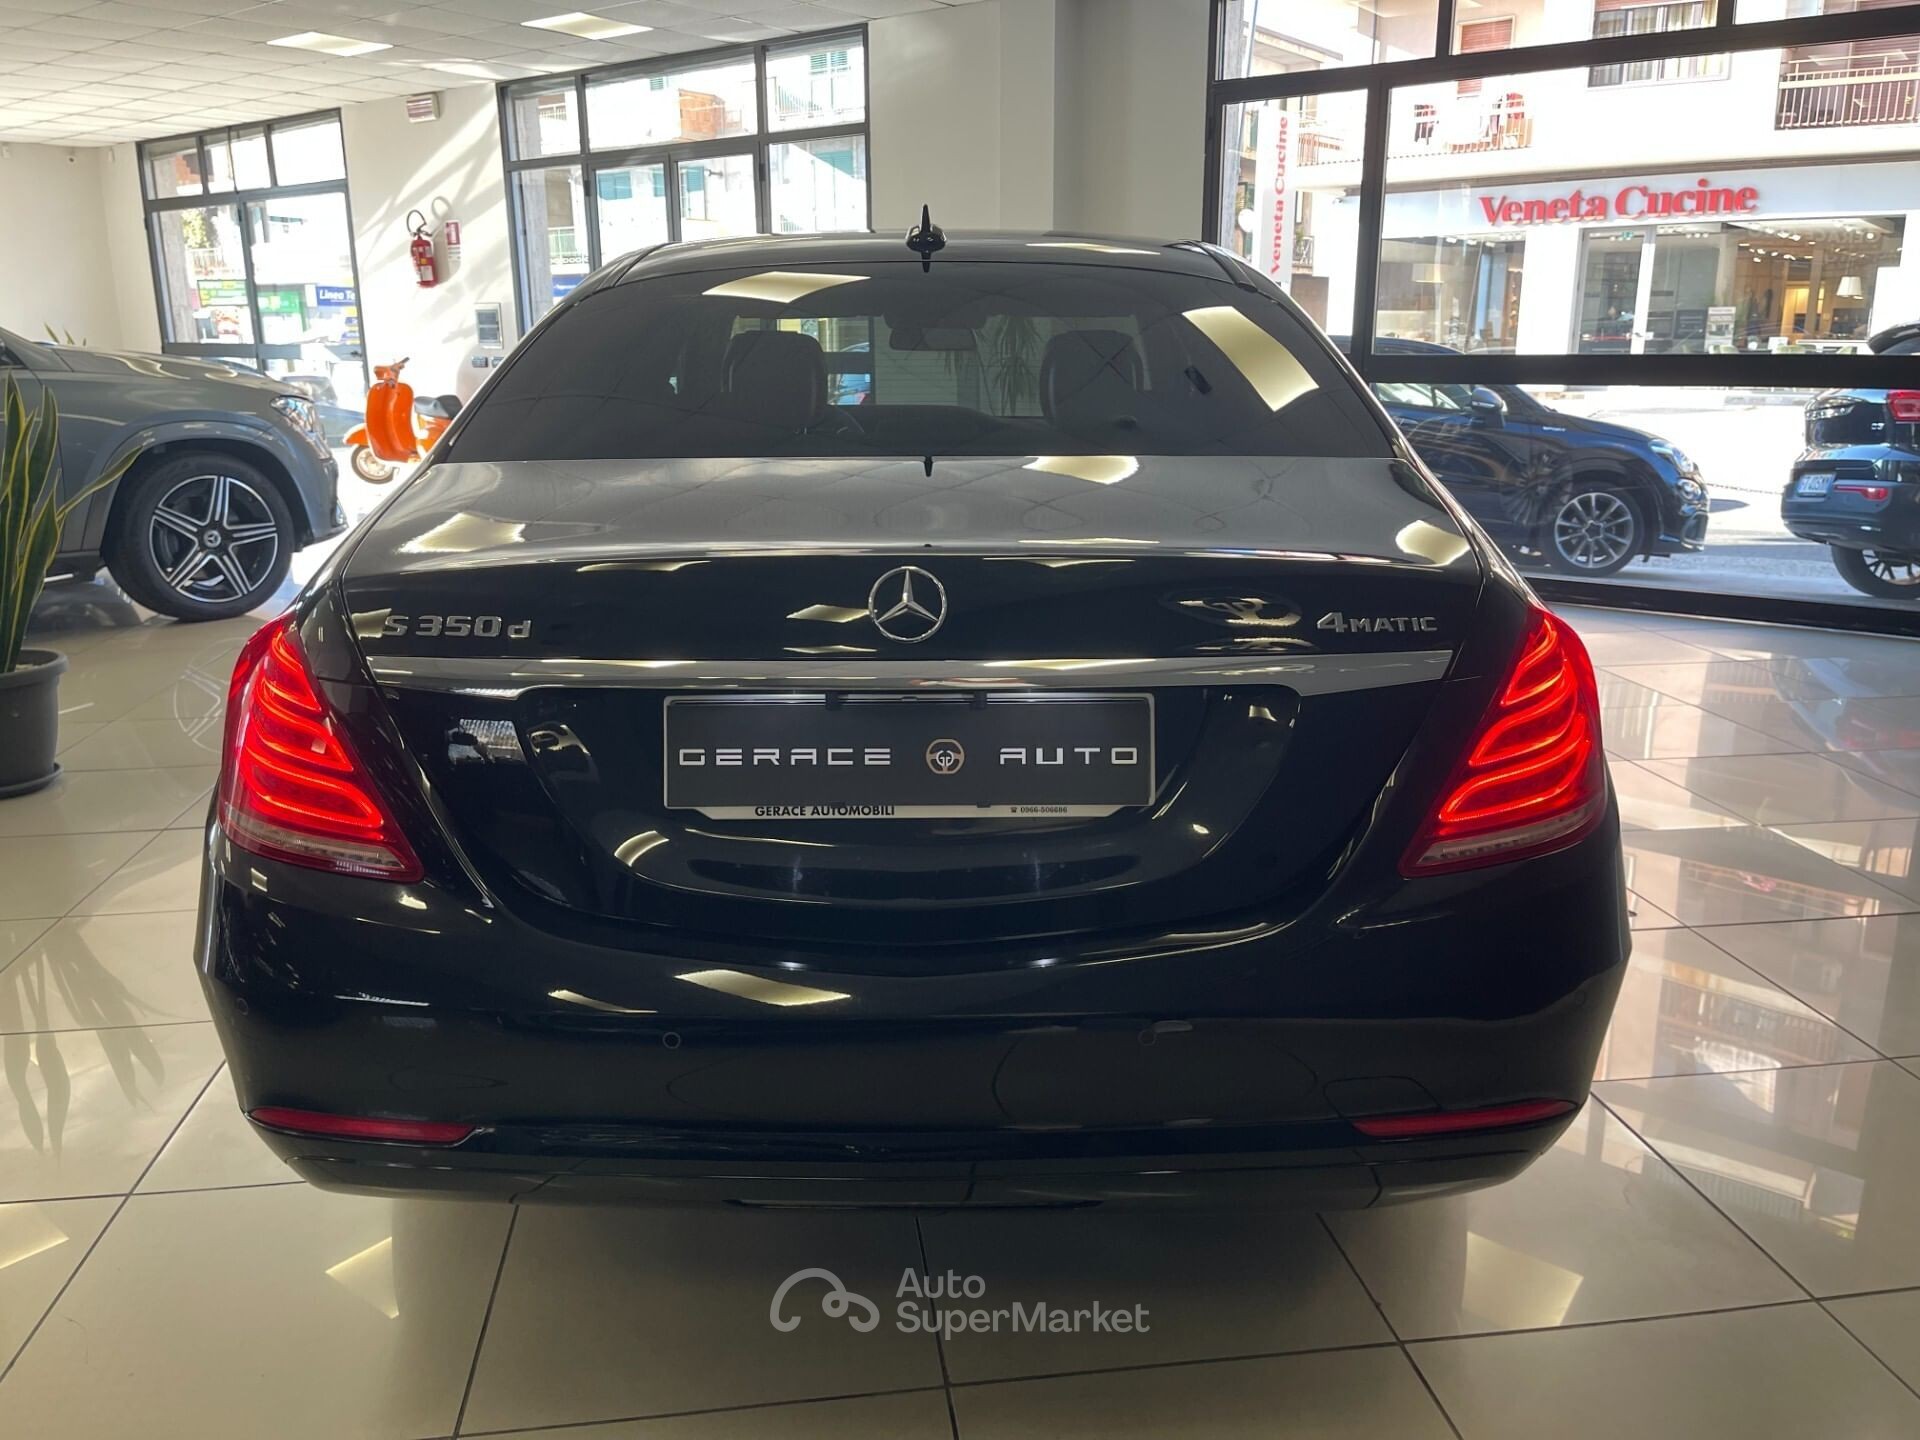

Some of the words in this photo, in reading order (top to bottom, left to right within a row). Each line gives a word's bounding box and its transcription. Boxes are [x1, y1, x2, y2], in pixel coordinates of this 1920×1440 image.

[1275, 116, 1288, 195] Cucine
[1478, 190, 1608, 226] Veneta
[1614, 178, 1759, 220] Cucine
[1270, 199, 1284, 274] Veneta
[1316, 612, 1438, 633] 4MATIC
[679, 748, 891, 766] GERACE
[1000, 747, 1138, 765] AUTO
[754, 806, 807, 817] GERACE
[811, 805, 896, 816] AUTOMOBILI
